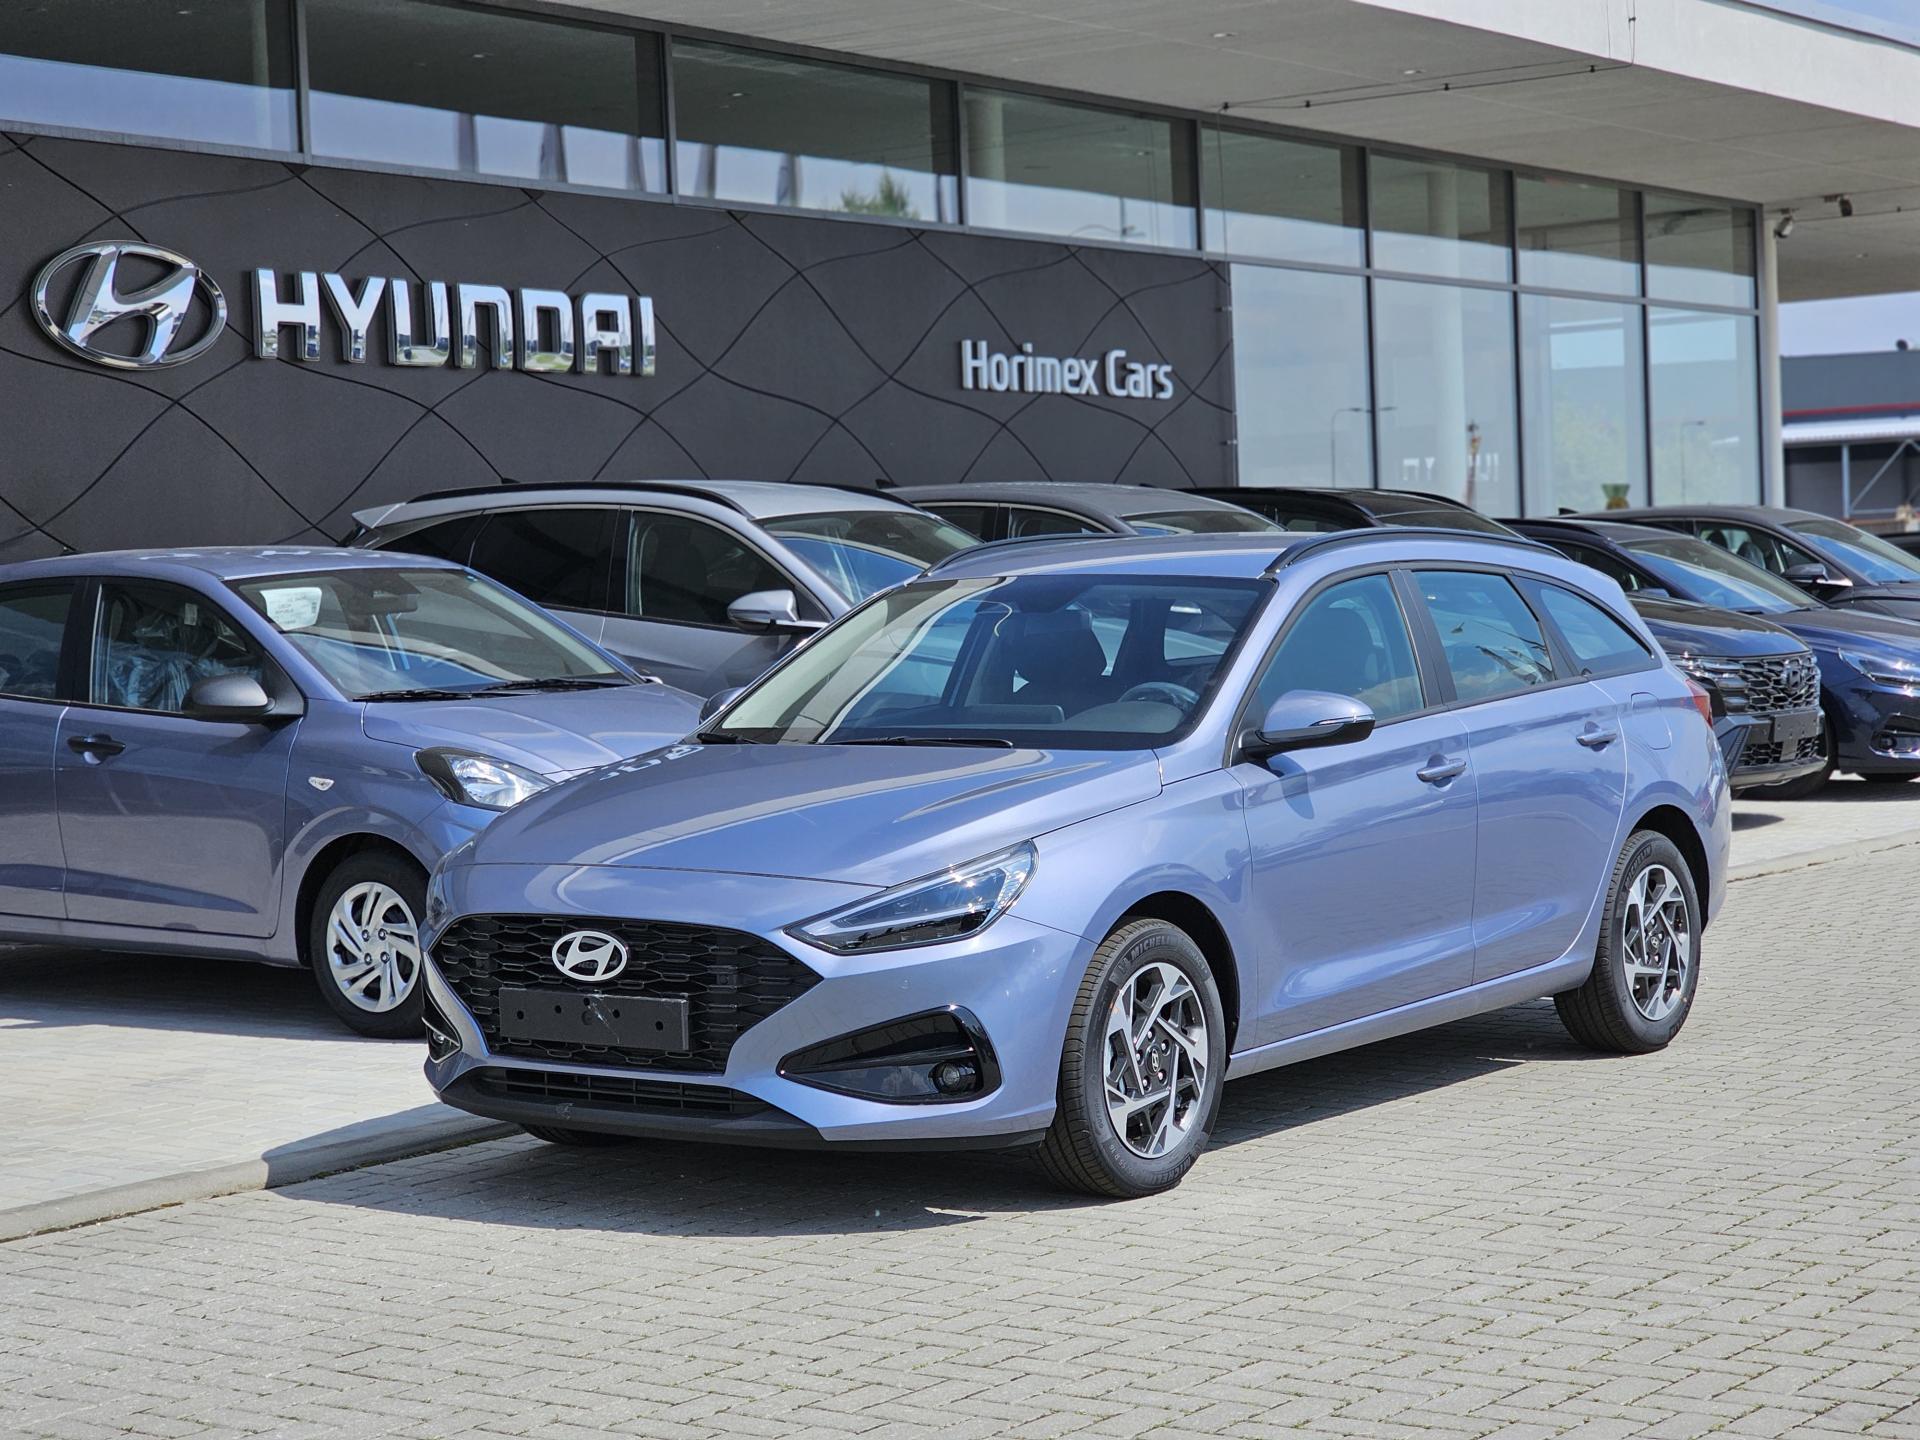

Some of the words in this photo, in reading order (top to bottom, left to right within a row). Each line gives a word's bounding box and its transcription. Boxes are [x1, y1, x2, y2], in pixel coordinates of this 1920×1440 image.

[252, 267, 656, 376] HYUNDAI
[960, 339, 1099, 396] Horimex
[1105, 349, 1174, 399] Cars
